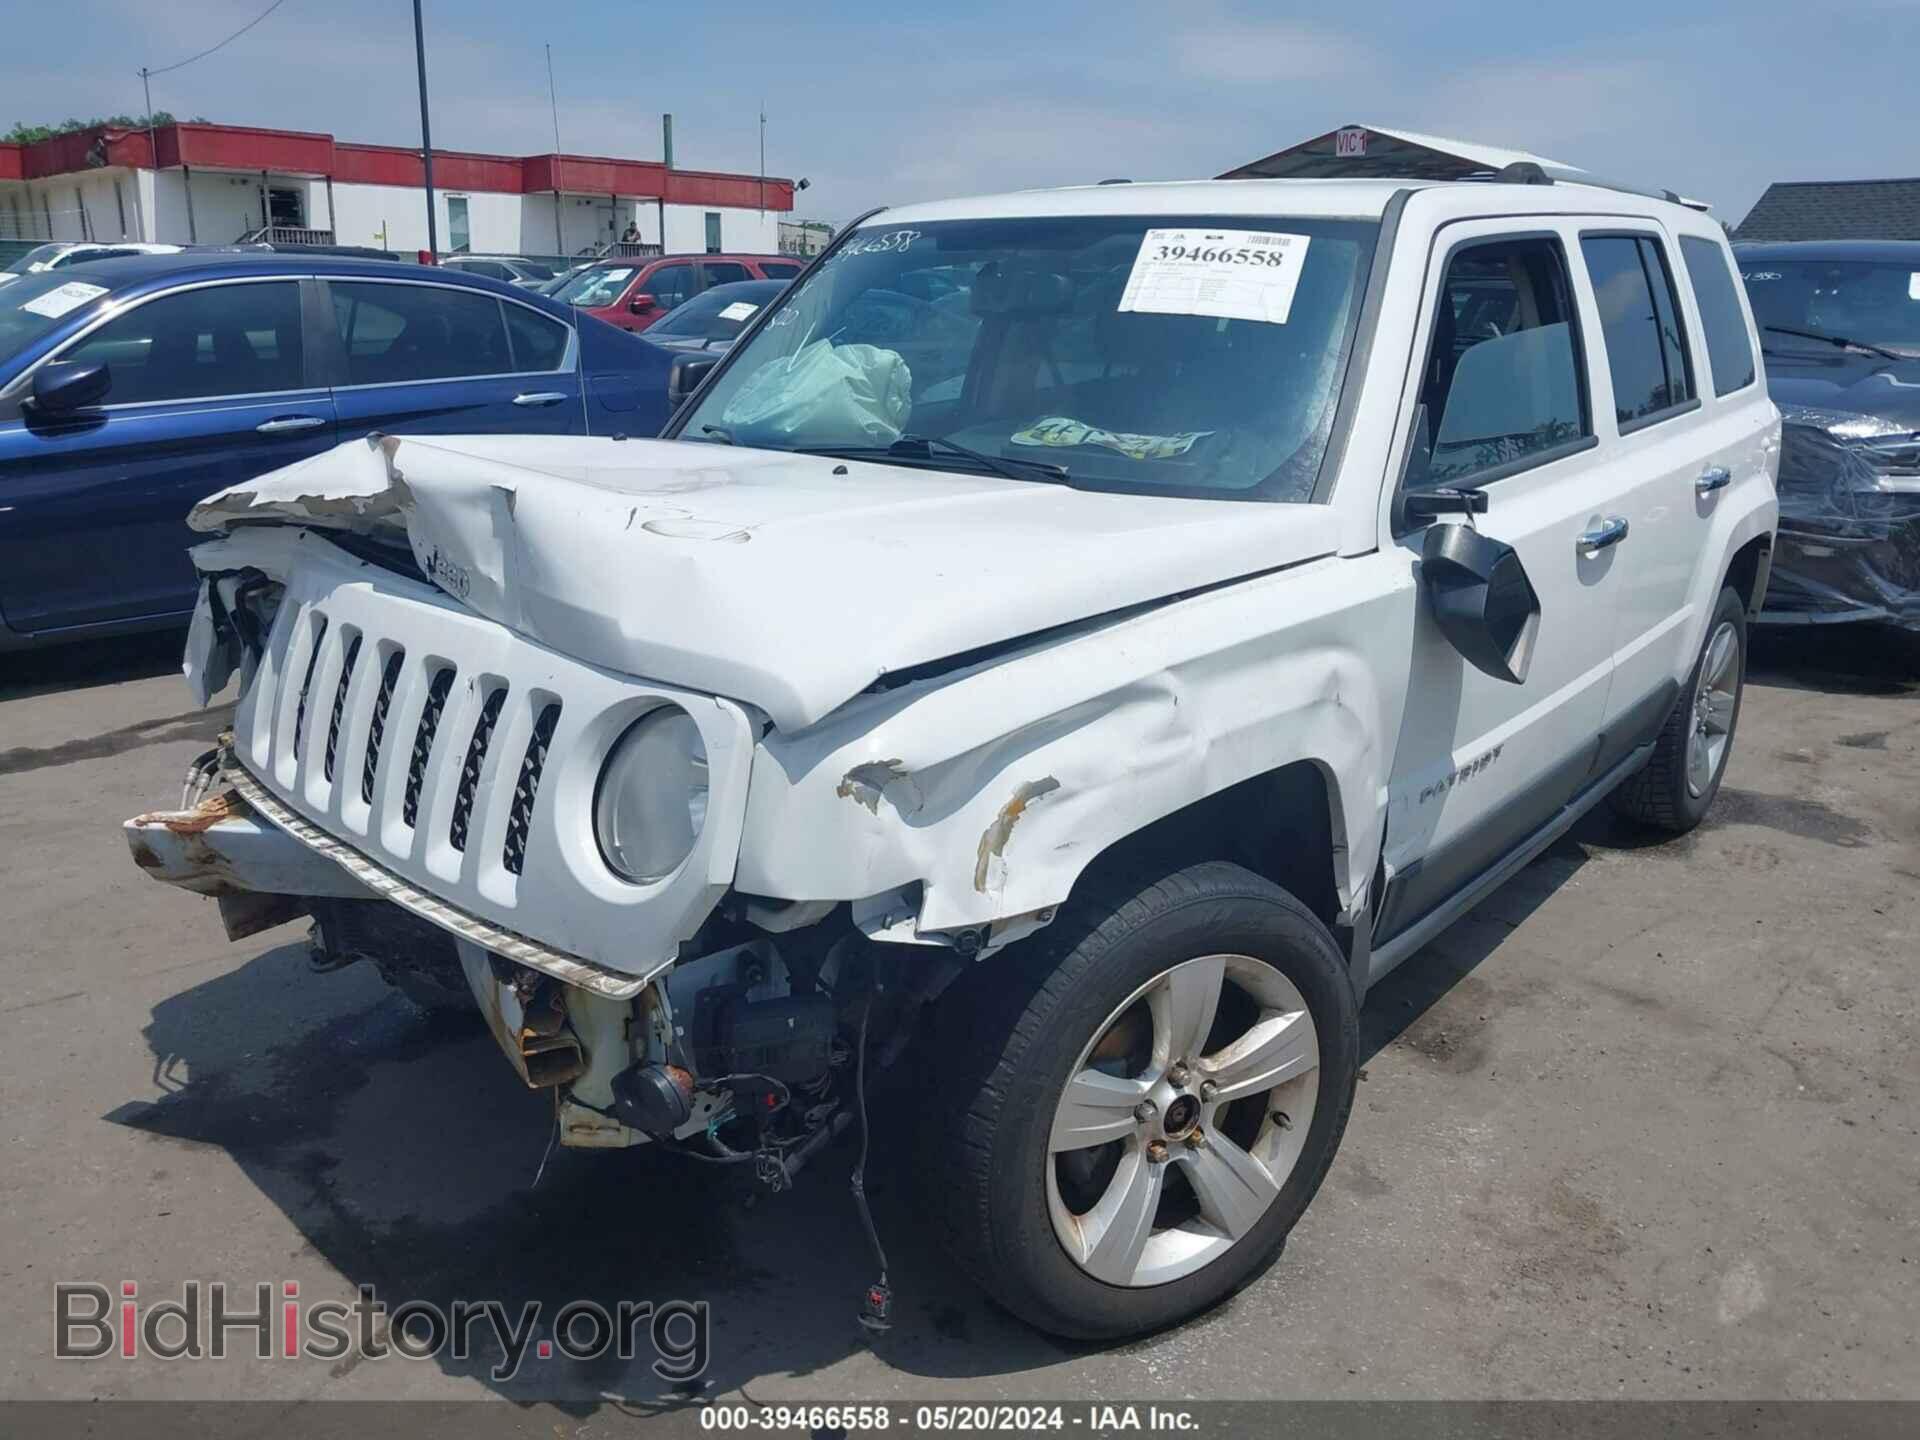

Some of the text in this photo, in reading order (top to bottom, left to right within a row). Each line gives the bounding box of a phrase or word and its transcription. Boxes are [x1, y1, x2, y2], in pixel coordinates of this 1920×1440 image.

[1338, 132, 1358, 152] VIC
[1152, 245, 1283, 267] 39466558
[424, 544, 471, 599] Jeep
[1419, 743, 1505, 804] PATRIOT
